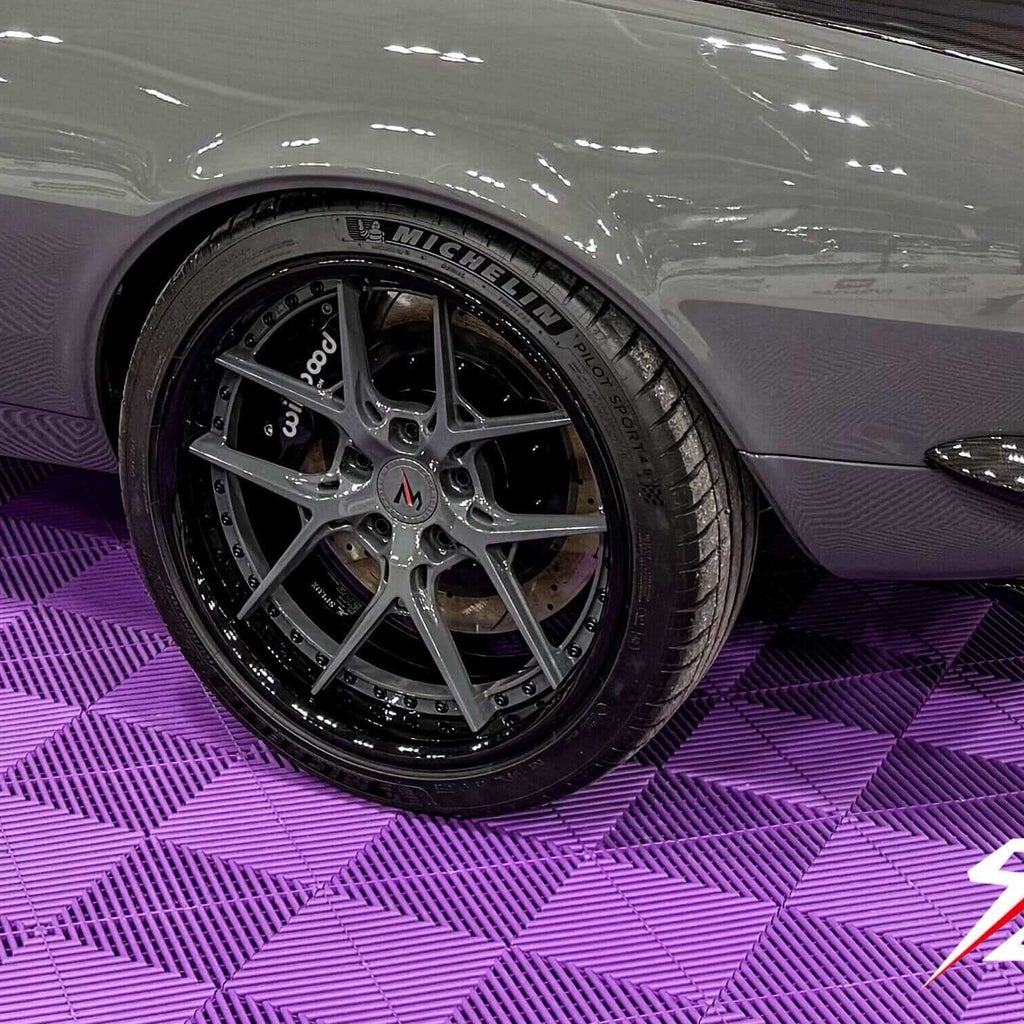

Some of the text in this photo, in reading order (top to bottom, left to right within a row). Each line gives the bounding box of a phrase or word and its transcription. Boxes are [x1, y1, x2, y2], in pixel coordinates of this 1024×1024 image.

[392, 225, 563, 327] MICHELIN
[282, 331, 337, 438] wiood
[574, 341, 613, 387] PILOT
[610, 394, 644, 451] SPORT
